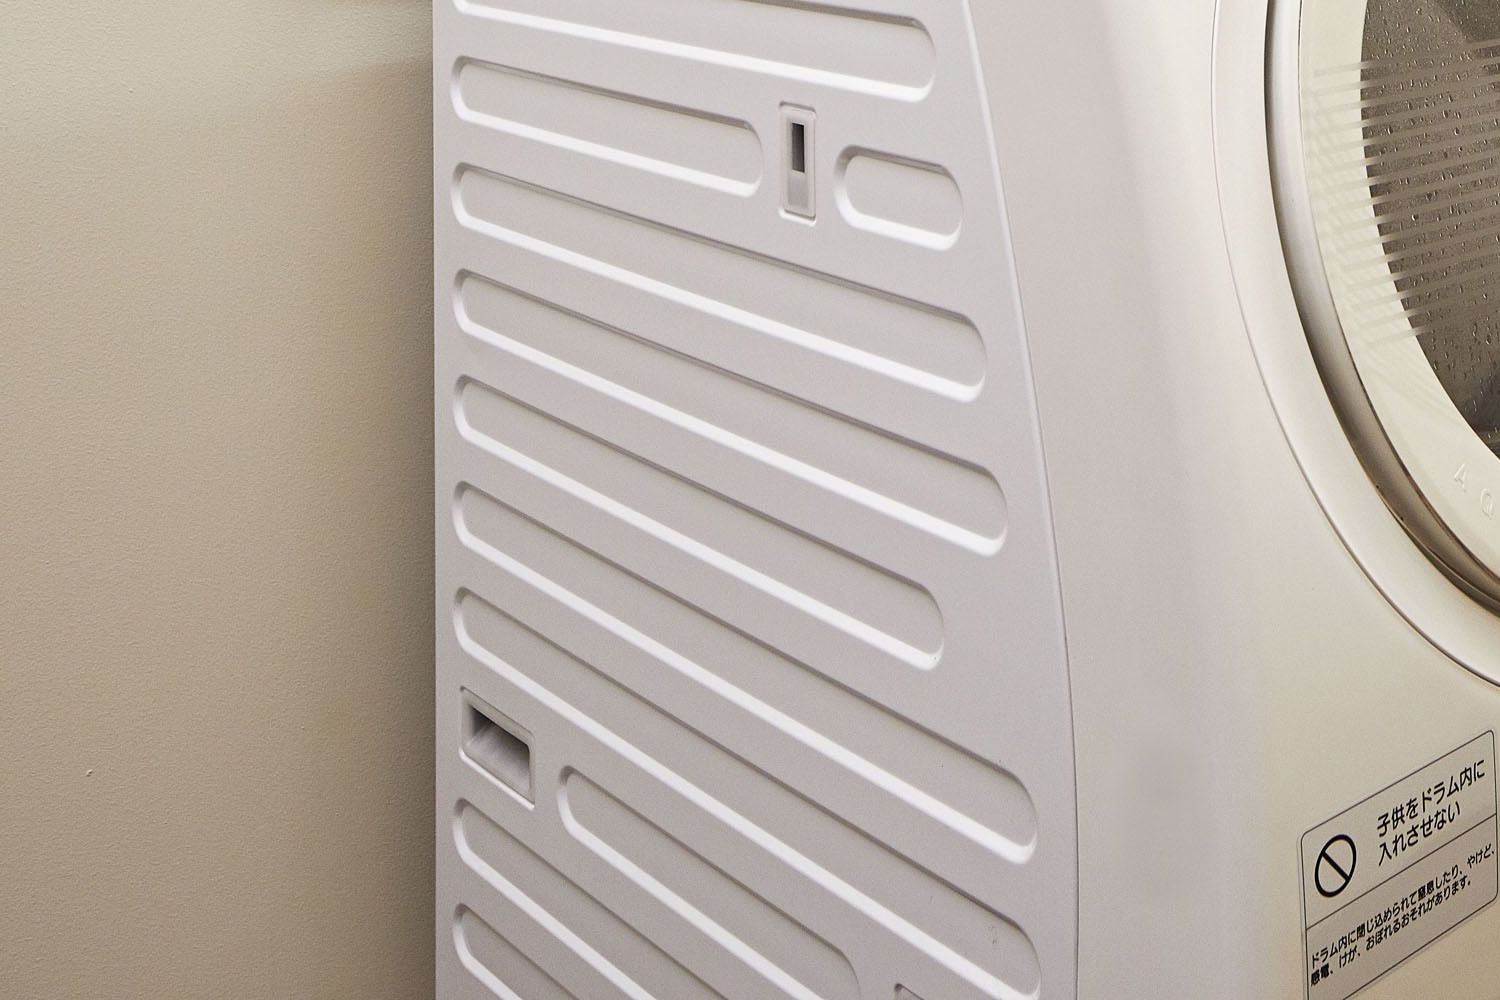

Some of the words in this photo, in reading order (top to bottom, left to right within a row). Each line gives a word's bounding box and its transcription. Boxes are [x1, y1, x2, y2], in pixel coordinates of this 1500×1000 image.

[1377, 759, 1486, 838] 子供をドラム内に
[1378, 801, 1461, 867] 入れさせない
